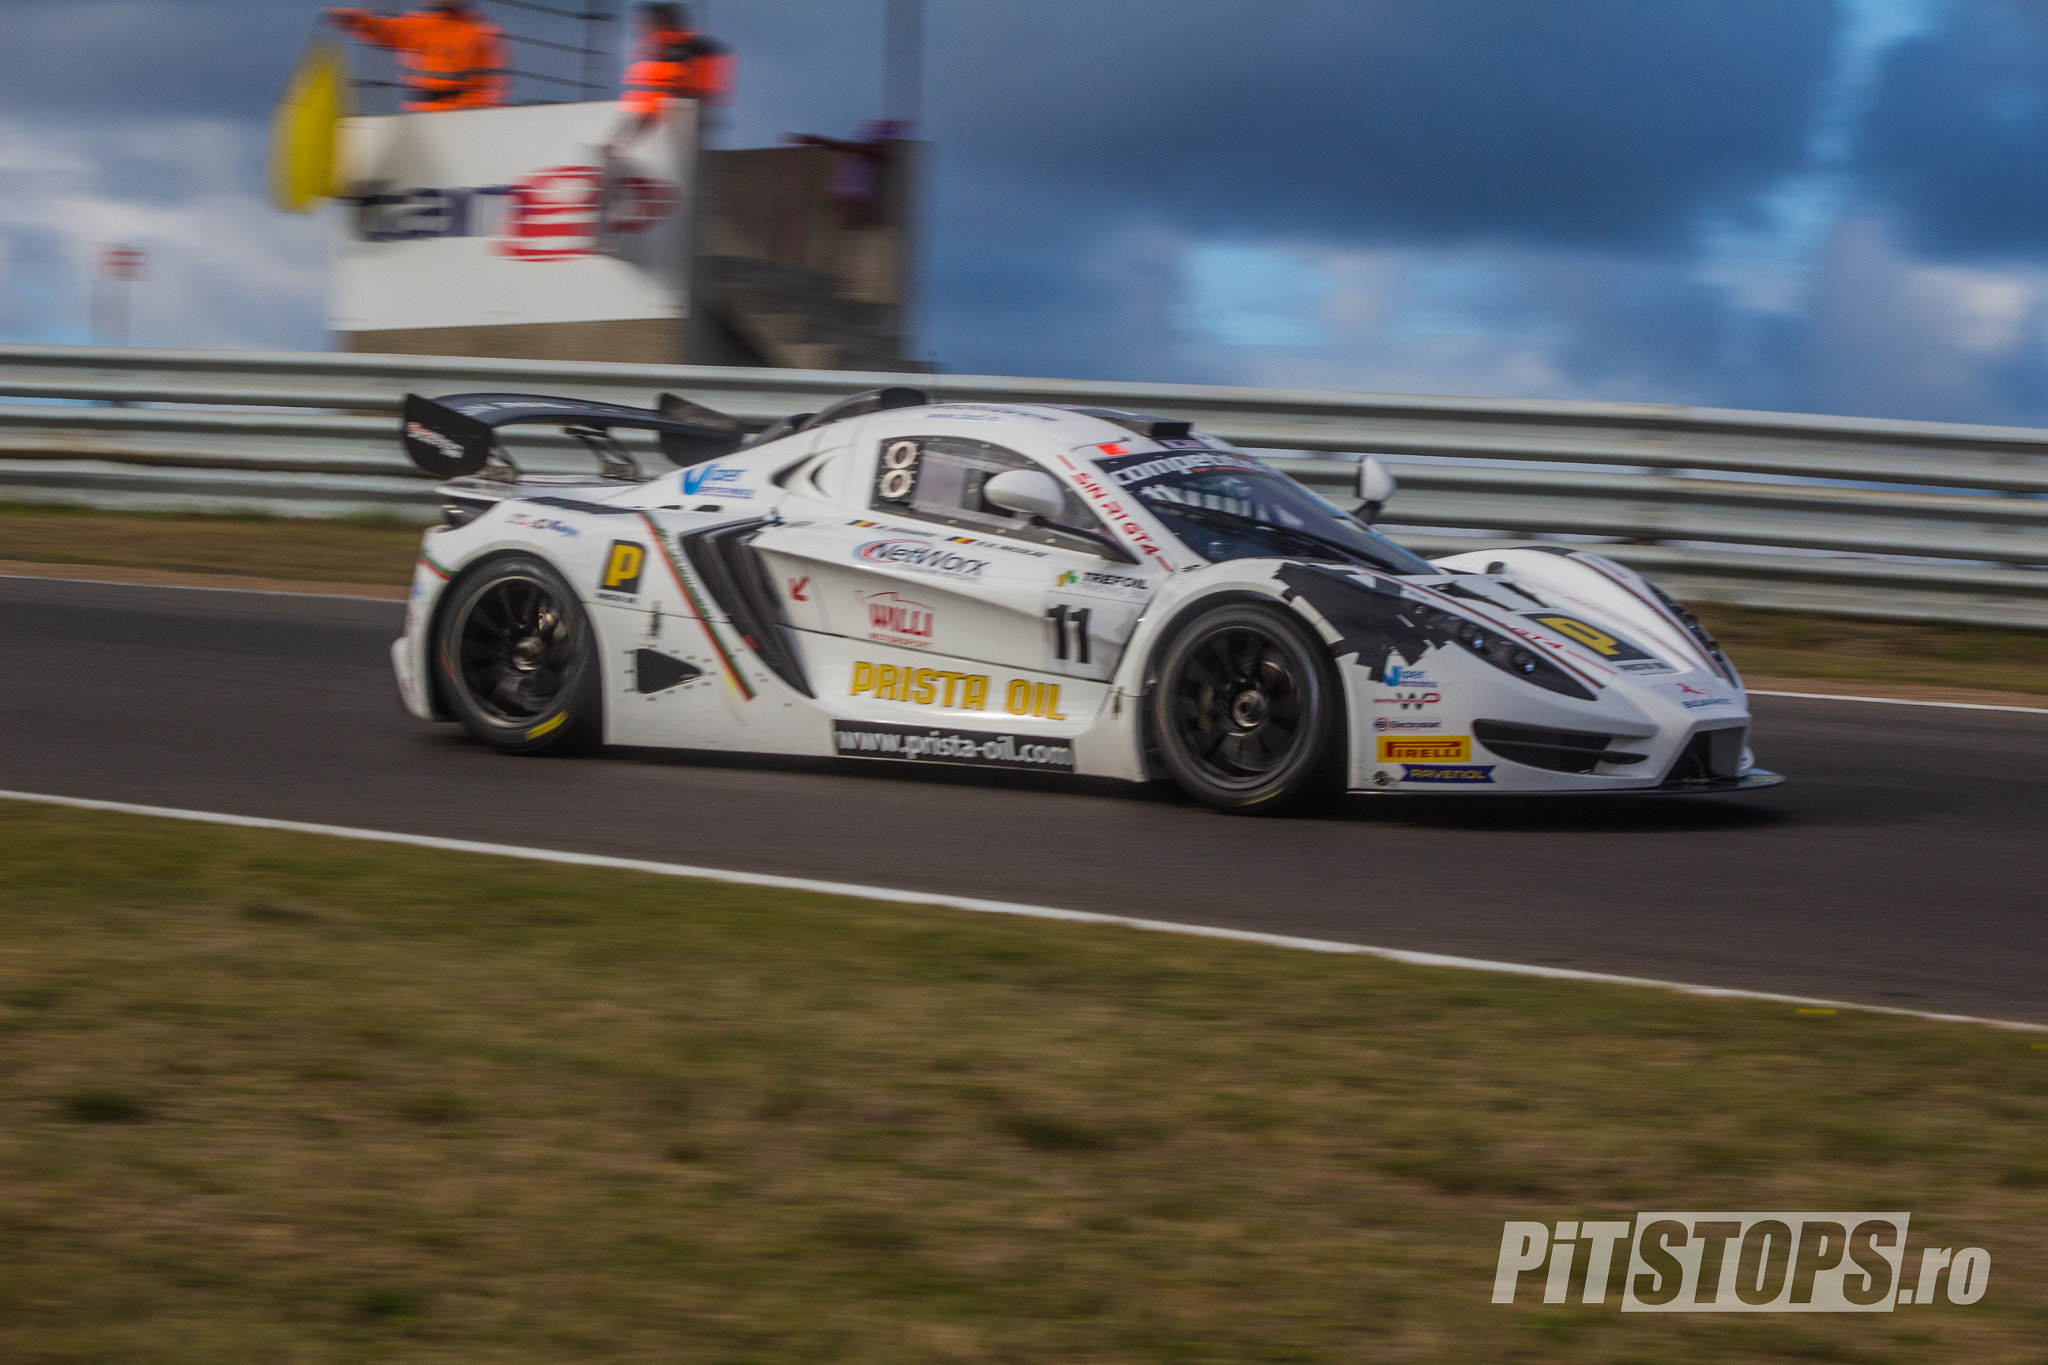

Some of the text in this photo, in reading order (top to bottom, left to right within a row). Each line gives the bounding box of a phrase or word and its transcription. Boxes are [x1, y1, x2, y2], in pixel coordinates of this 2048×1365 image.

[1069, 473, 1107, 500] SIN
[1120, 522, 1162, 556] GT4
[602, 544, 644, 586] P
[1082, 572, 1149, 589] TREFOIL
[868, 603, 935, 638] WILLI
[1045, 604, 1092, 664] 11
[850, 661, 1068, 721] PRISTA OIL
[836, 730, 1075, 767] www.prista-oil.com
[1386, 741, 1462, 758] PIRELLI
